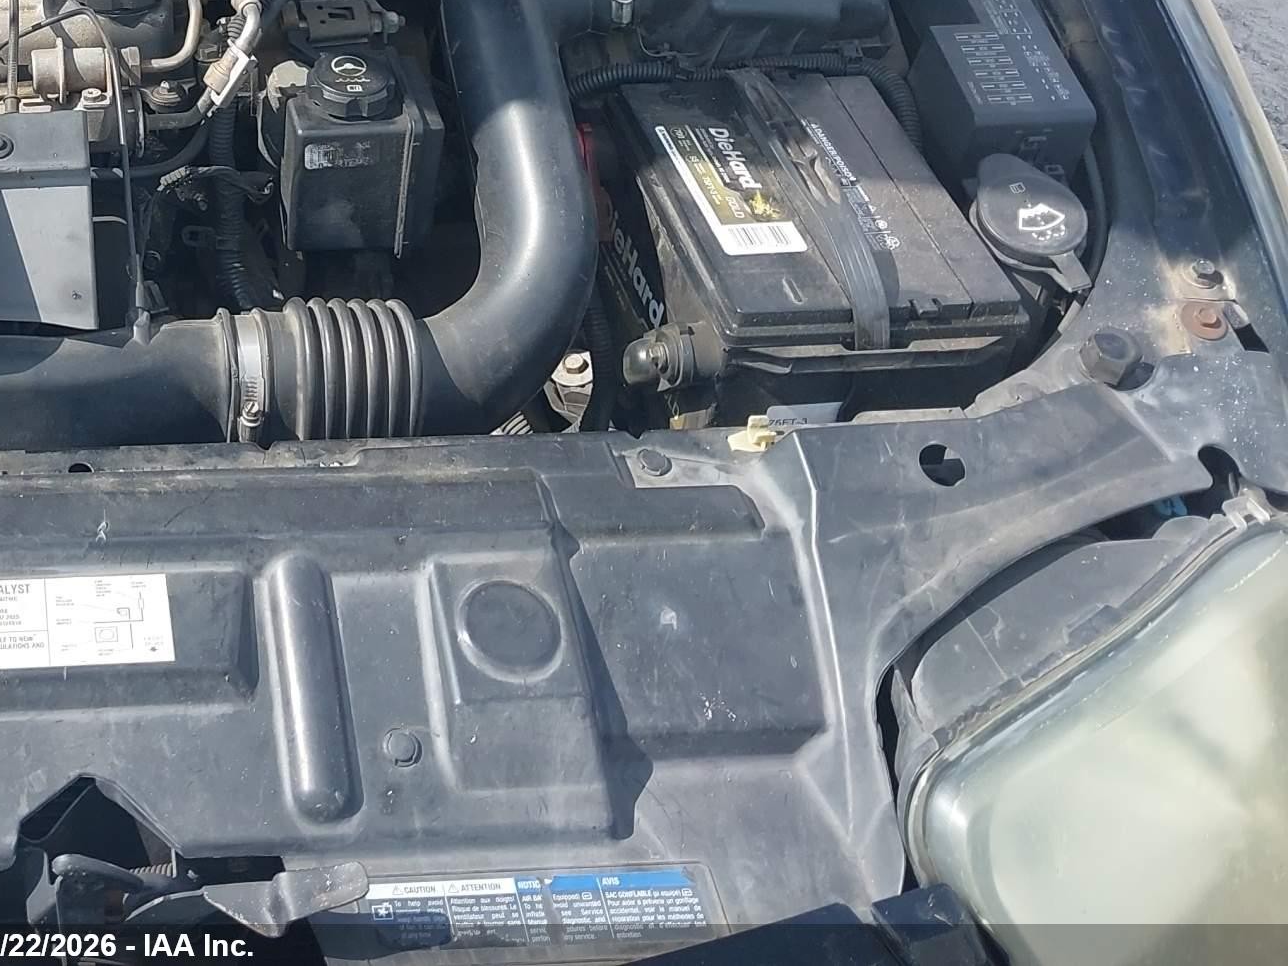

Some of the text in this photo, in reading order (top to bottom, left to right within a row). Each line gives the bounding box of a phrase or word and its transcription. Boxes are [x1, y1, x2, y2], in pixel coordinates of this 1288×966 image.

[709, 127, 762, 188] DieHard
[725, 197, 745, 218] GOLD
[613, 210, 664, 328] ieHard
[517, 880, 541, 889] NOTIC
[602, 877, 619, 885] AVIS
[404, 886, 436, 894] CAUTION
[462, 883, 501, 891] ATTENTION
